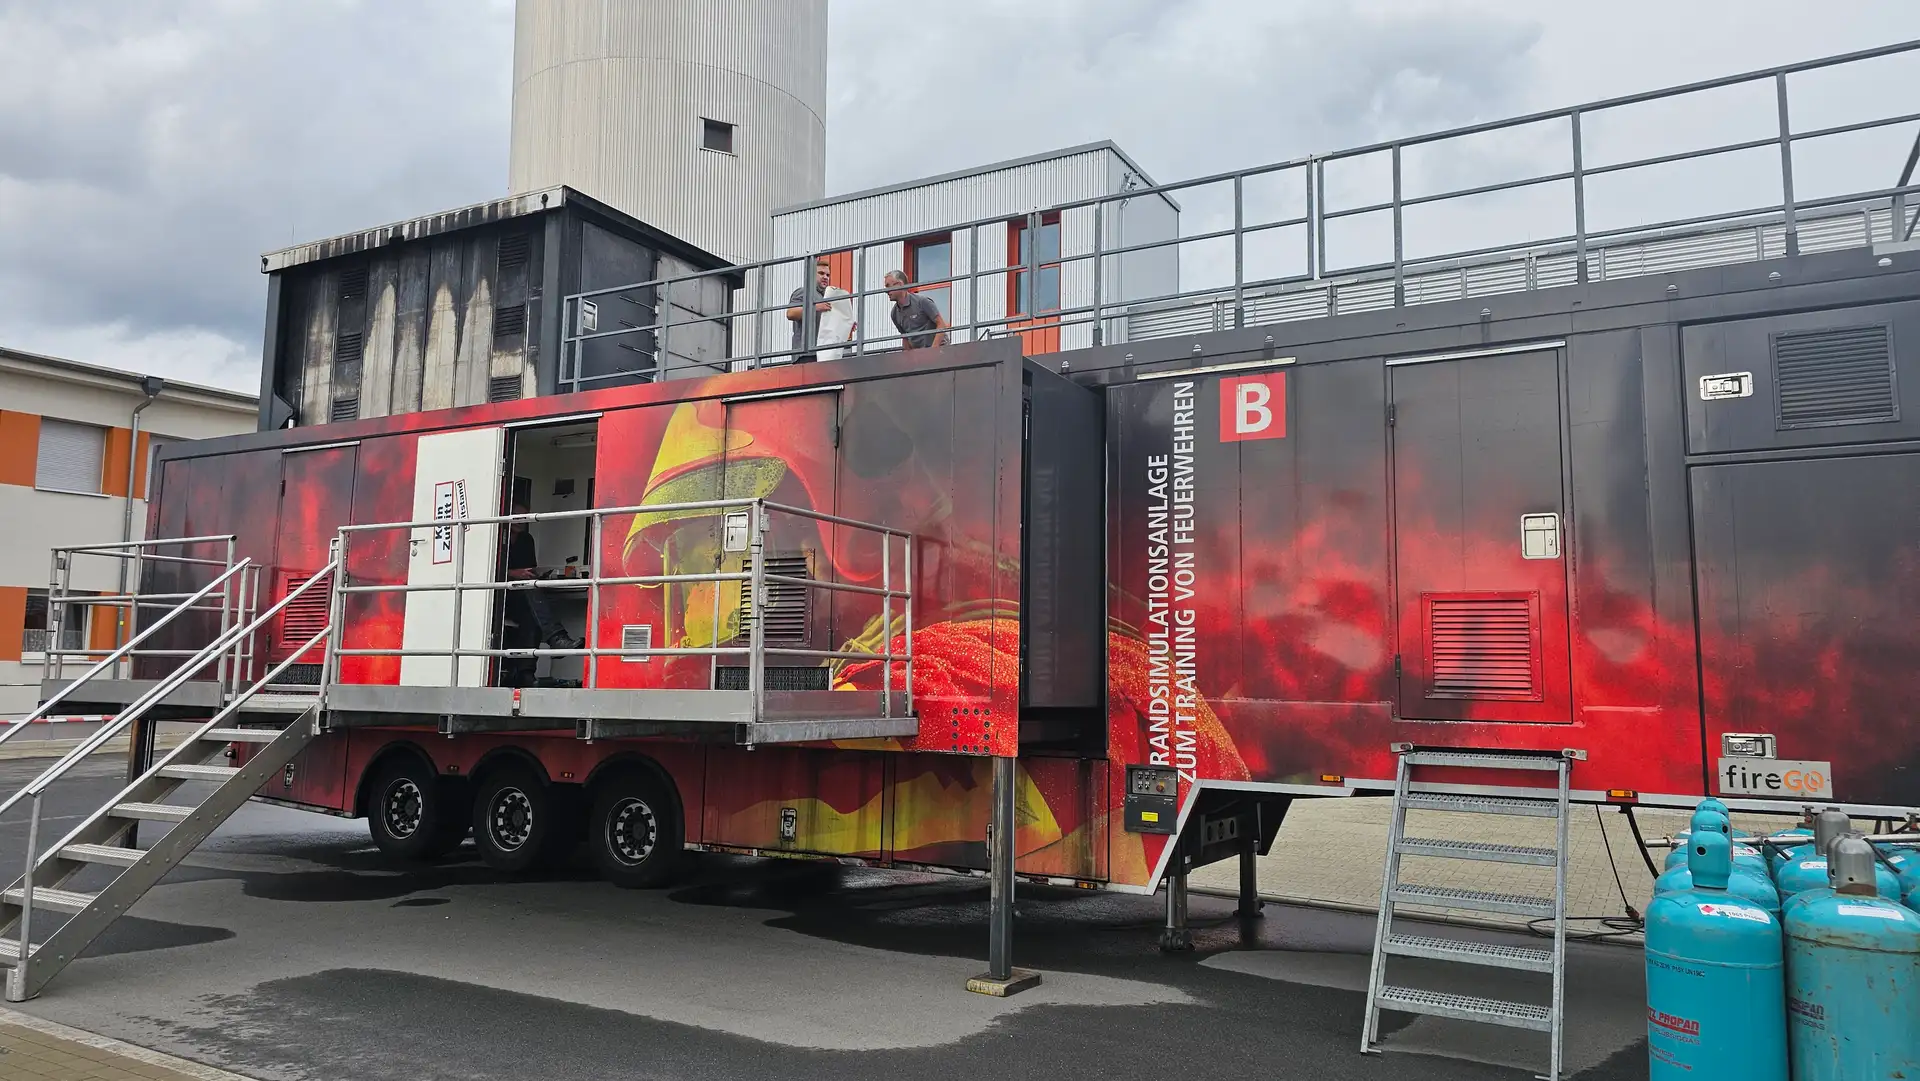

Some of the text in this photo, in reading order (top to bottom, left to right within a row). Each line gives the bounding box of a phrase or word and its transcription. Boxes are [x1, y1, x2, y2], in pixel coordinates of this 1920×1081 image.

[1236, 382, 1273, 434] B
[1174, 381, 1195, 543] FEUERWEHREN
[435, 506, 444, 540] Kin
[442, 502, 452, 550] Zutitt
[457, 482, 469, 530] itstand
[1174, 552, 1195, 602] VON
[1147, 454, 1170, 766] RANDSIMULATIONSANLAGE
[1175, 734, 1197, 783] ZUM
[1726, 764, 1825, 793] fireGO
[1659, 1011, 1700, 1031] PROPAN
